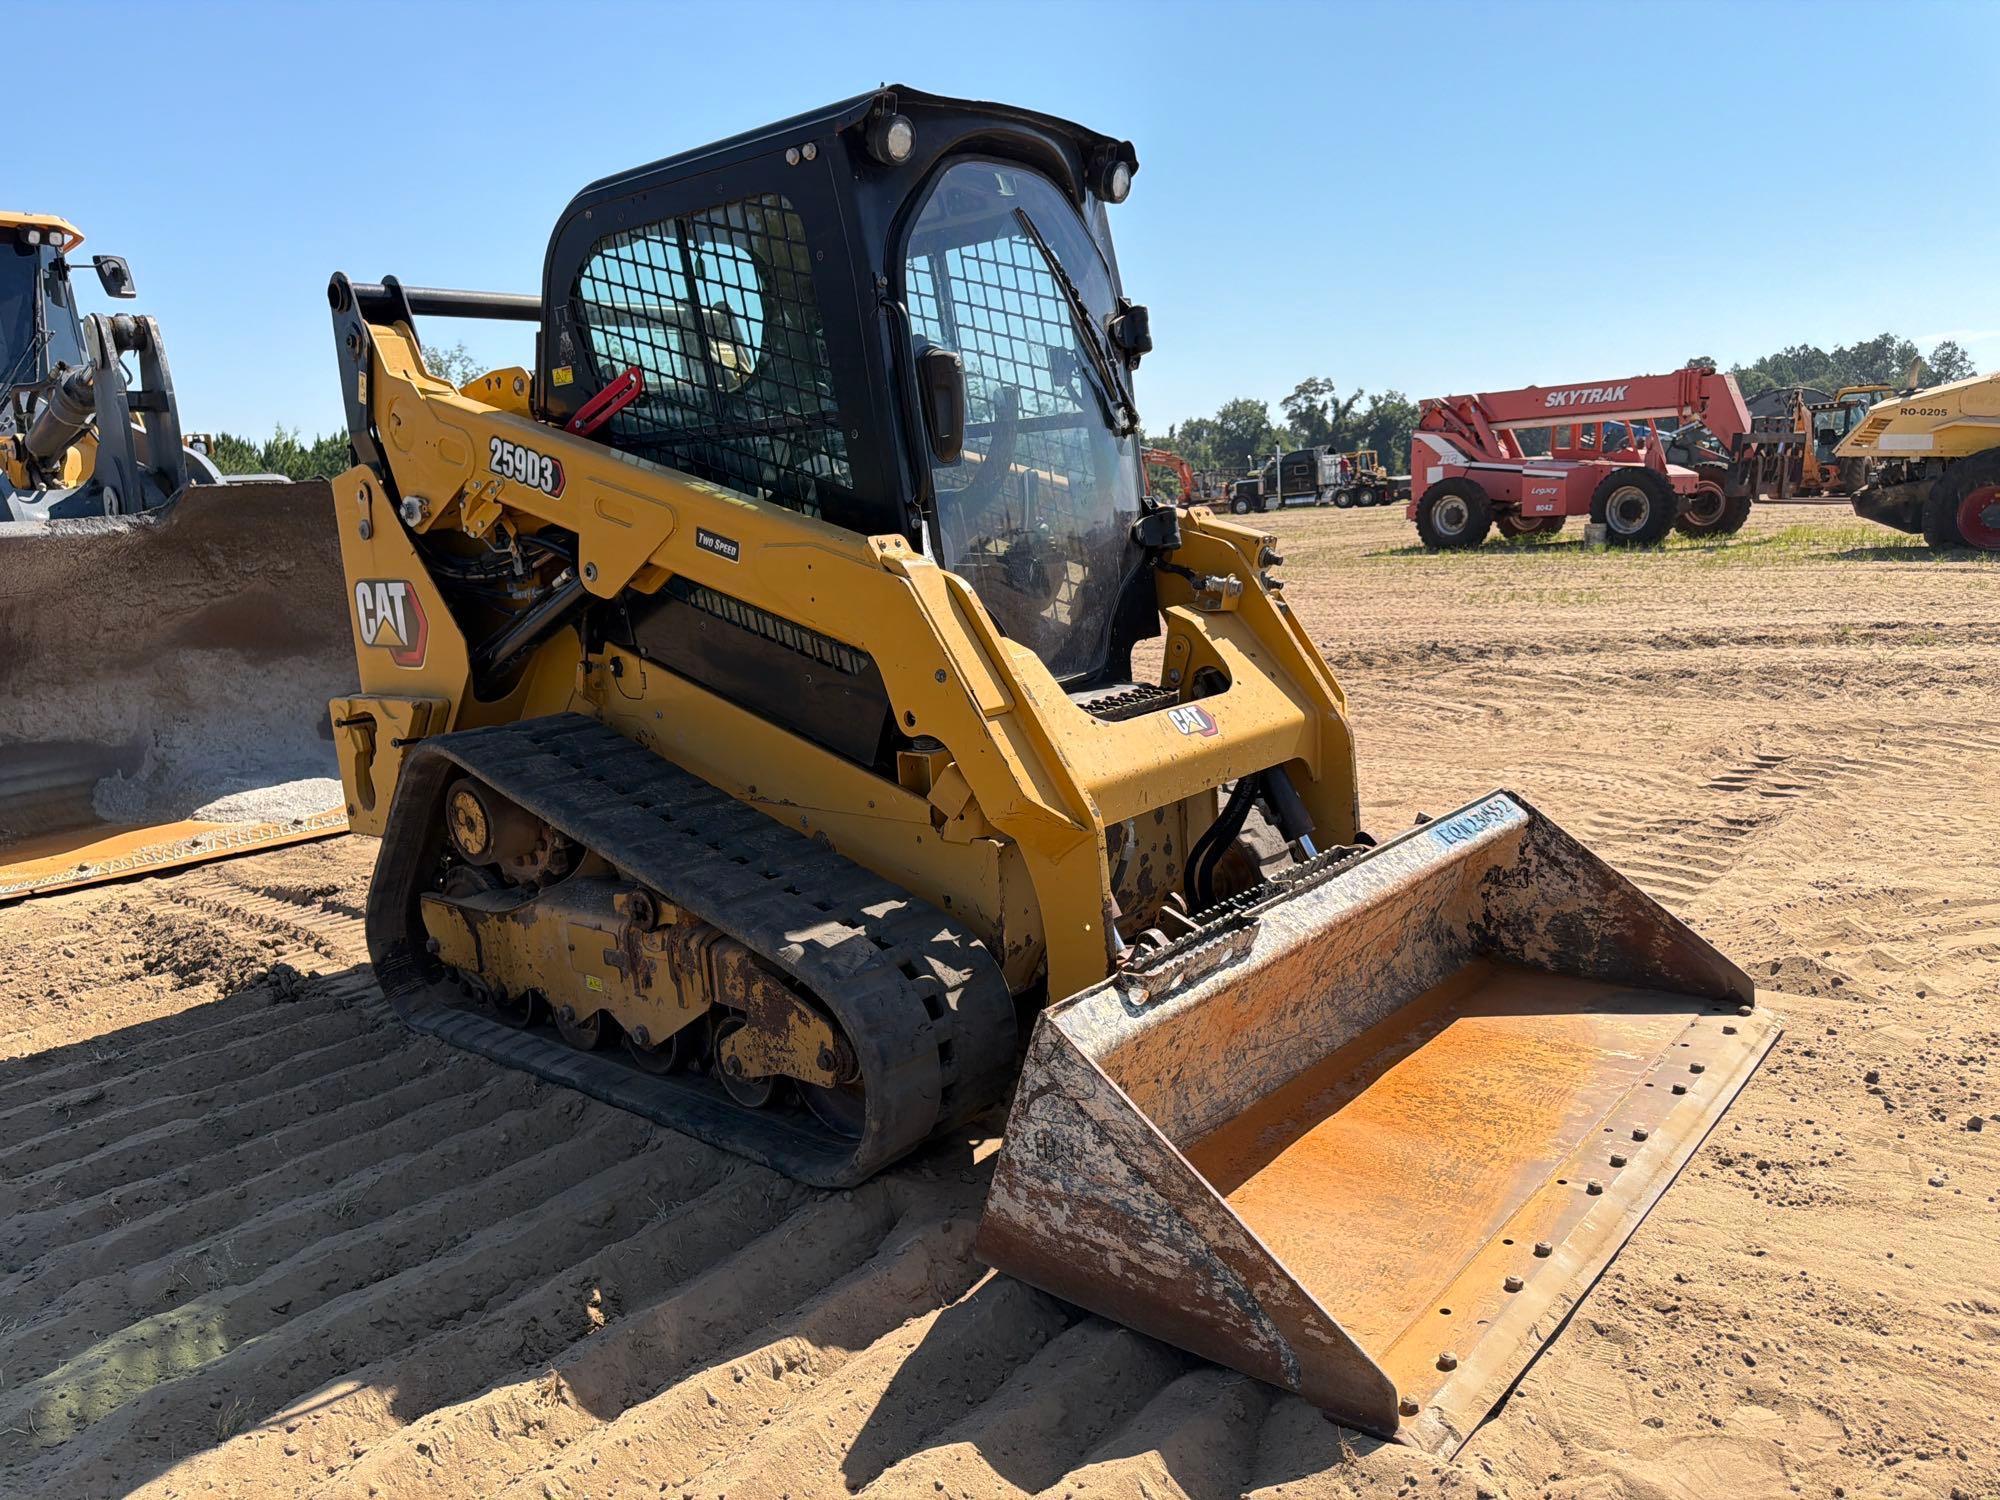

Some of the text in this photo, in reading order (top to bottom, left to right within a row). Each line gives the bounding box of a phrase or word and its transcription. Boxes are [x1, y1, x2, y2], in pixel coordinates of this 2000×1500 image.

[1544, 385, 1629, 408] SKYTRAK
[1900, 407, 1948, 417] RO-0205
[490, 437, 554, 493] 259D3
[355, 581, 409, 647] CAT
[1167, 705, 1209, 734] CAT
